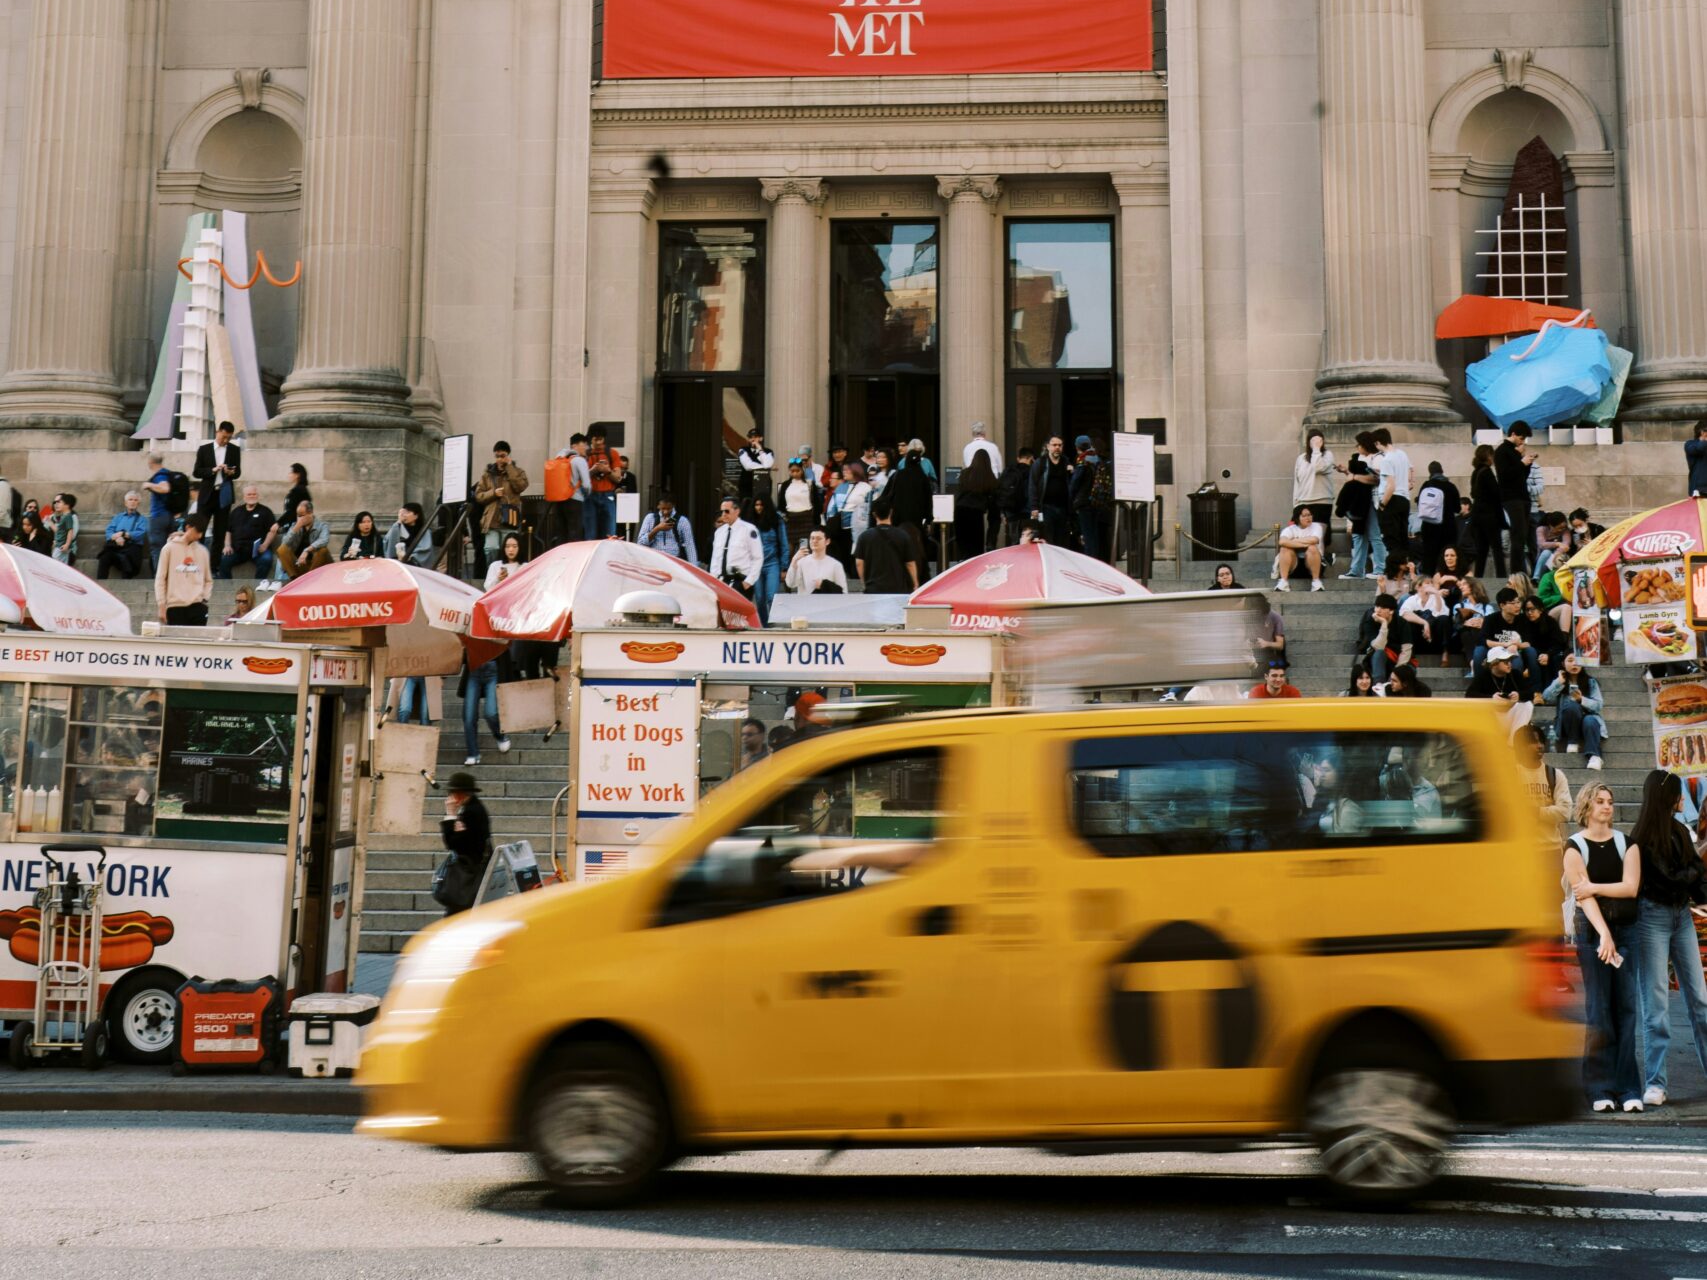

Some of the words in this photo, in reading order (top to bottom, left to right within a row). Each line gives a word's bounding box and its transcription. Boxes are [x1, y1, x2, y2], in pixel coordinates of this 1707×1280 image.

[828, 11, 925, 57] MET
[1633, 533, 1681, 554] NIKAS
[299, 605, 337, 621] COLD
[339, 601, 393, 619] DRINKS
[440, 608, 460, 622] HOT
[1639, 611, 1659, 619] Lamb
[1661, 611, 1678, 619] Gyro
[55, 617, 73, 630] HOT
[15, 649, 50, 661] BEST
[54, 650, 84, 663] HOT
[89, 652, 128, 665] DOGS
[133, 654, 150, 666] IN
[155, 655, 188, 668] NEW
[194, 657, 233, 670] YORK
[722, 641, 774, 664] NEW
[784, 642, 845, 665] YORK
[616, 694, 659, 712] Best
[592, 724, 626, 741] Hot
[634, 724, 683, 746] Dogs
[628, 752, 646, 771] in
[588, 783, 632, 802] New
[640, 783, 685, 802] York
[194, 1024, 229, 1033] 3500
